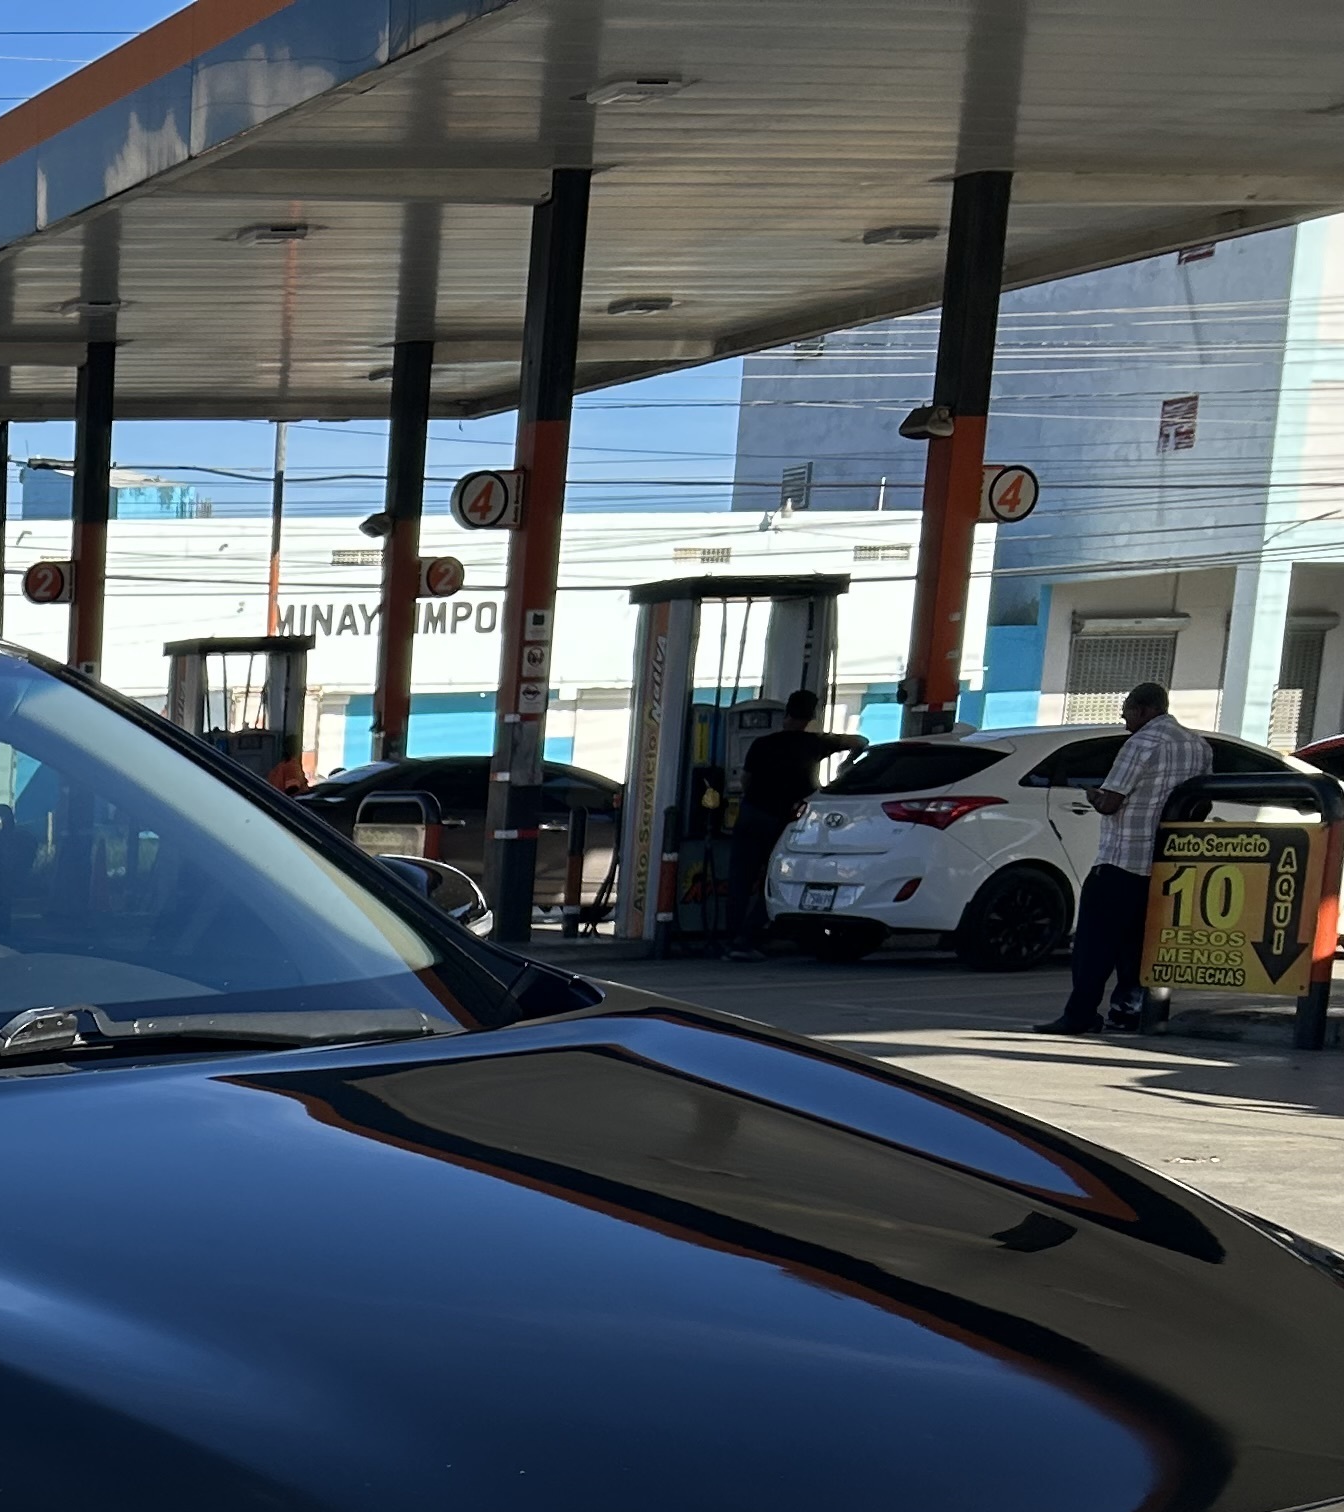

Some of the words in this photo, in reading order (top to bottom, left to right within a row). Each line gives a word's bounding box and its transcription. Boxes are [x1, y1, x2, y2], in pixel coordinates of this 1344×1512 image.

[468, 479, 495, 521] 4
[997, 473, 1025, 514] 4
[33, 568, 54, 599] 2
[433, 562, 455, 591] 2
[1164, 836, 1201, 855] Auto
[1204, 835, 1269, 855] Servicio
[1163, 864, 1246, 929] 10
[1272, 847, 1297, 956] AQUI
[1160, 929, 1246, 947] PESOS
[1157, 948, 1244, 966] MENOS
[1153, 964, 1172, 982] TU
[1174, 965, 1192, 984] LA
[1196, 967, 1245, 986] ECHAS
